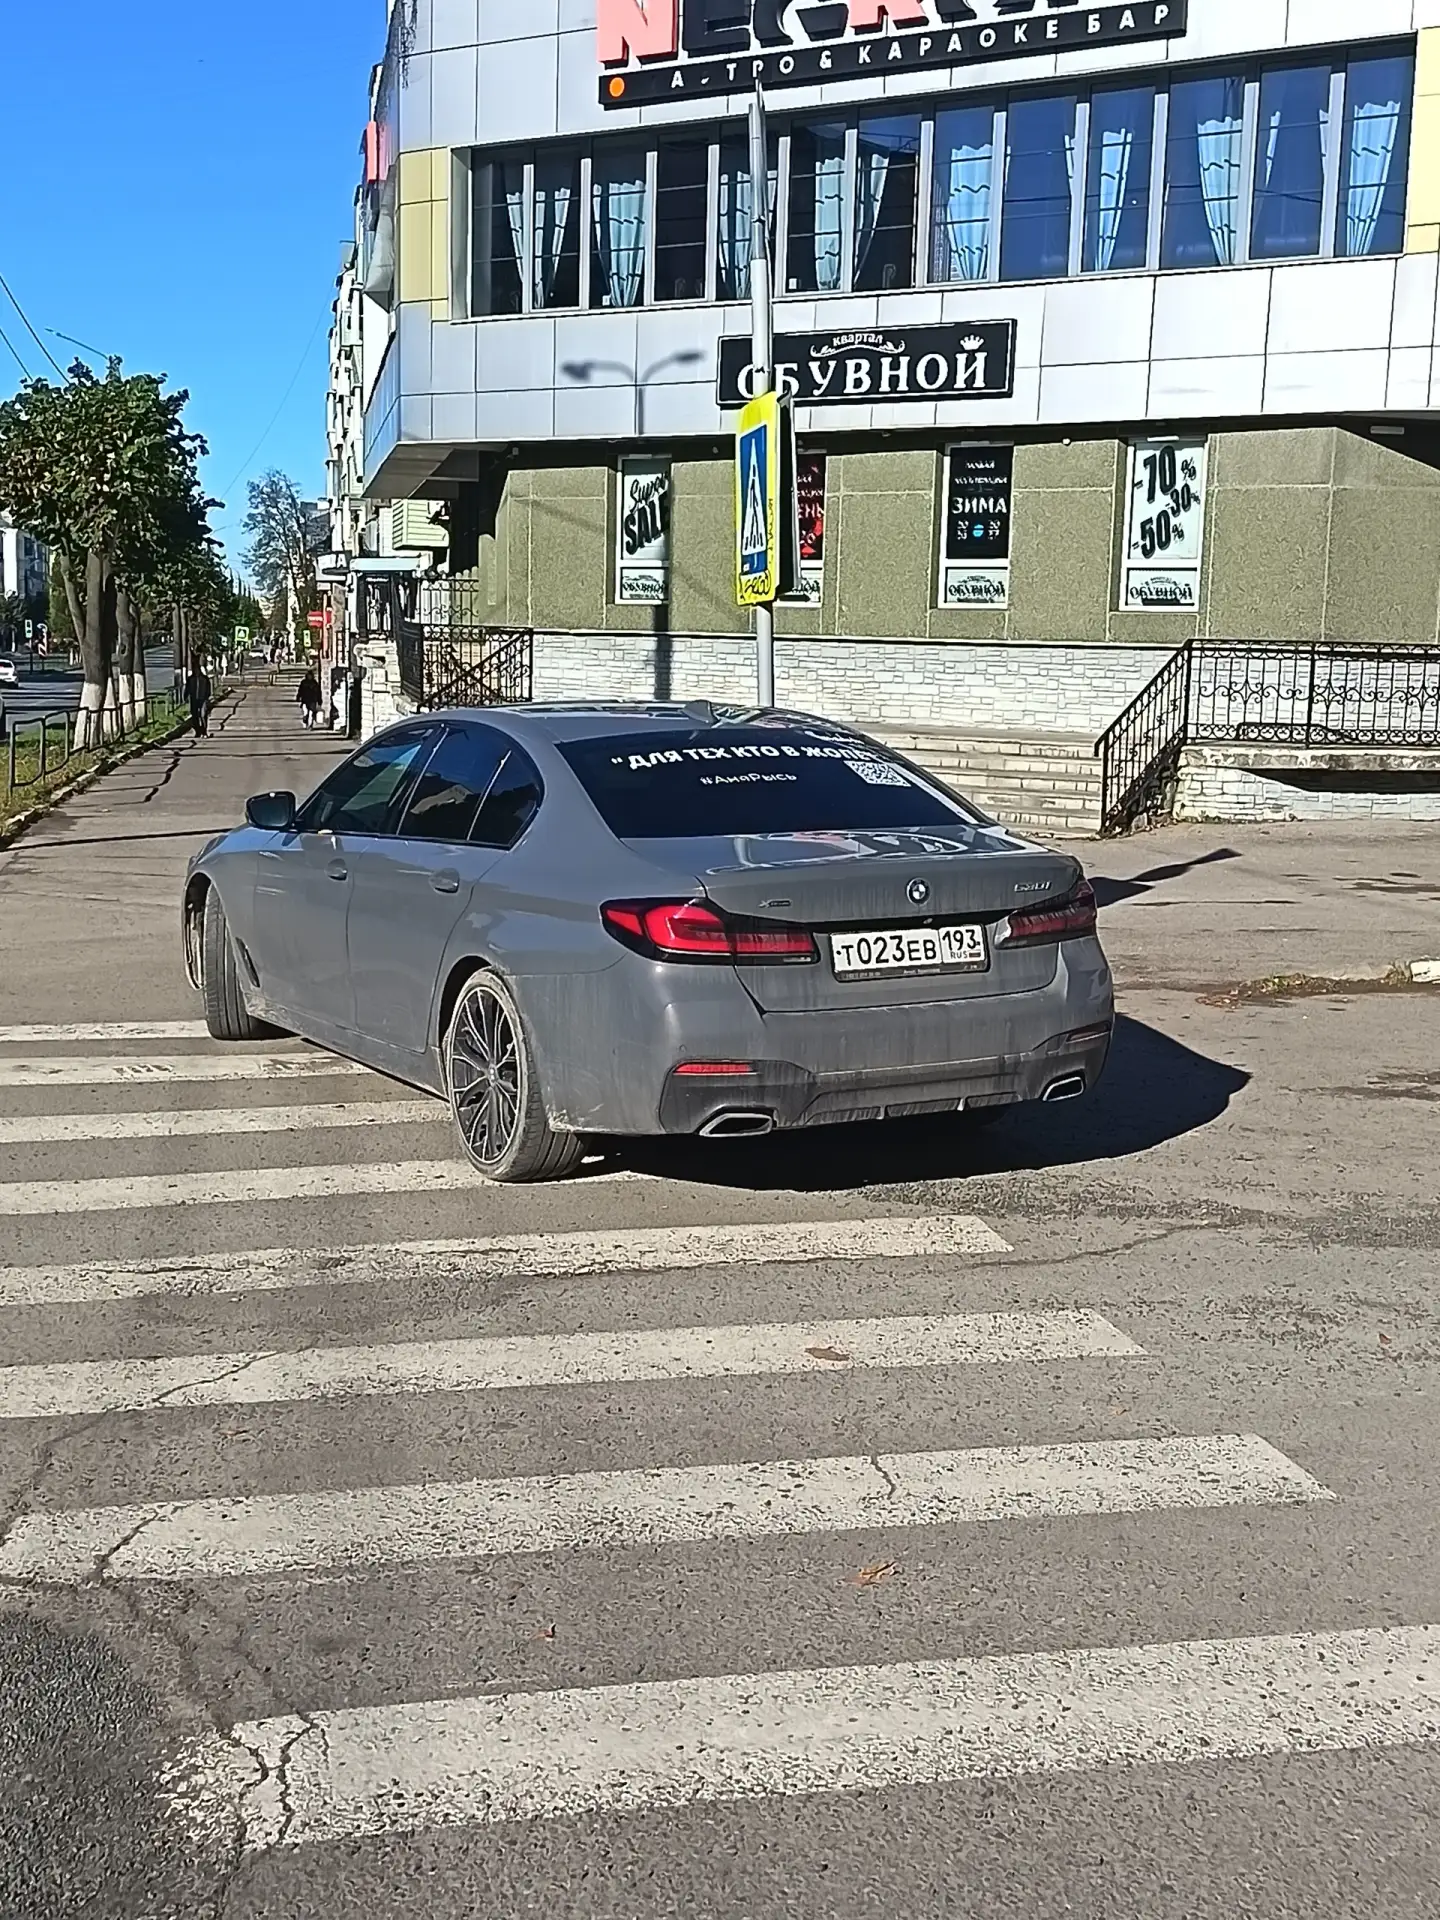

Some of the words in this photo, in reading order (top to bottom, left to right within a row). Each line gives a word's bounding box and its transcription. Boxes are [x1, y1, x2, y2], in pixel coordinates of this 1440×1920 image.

[671, 57, 795, 89] АТРО
[858, 19, 1058, 64] КАРАОКЕ
[1087, 4, 1169, 34] БАР
[832, 333, 883, 347] квартал
[952, 497, 1007, 515] ЗИМА
[682, 747, 732, 760] ТЕХ
[730, 745, 780, 758] КТО
[780, 745, 800, 757] В
[841, 935, 937, 966] Т023ЕВ
[942, 929, 977, 951] 193
[950, 951, 968, 960] RUS
